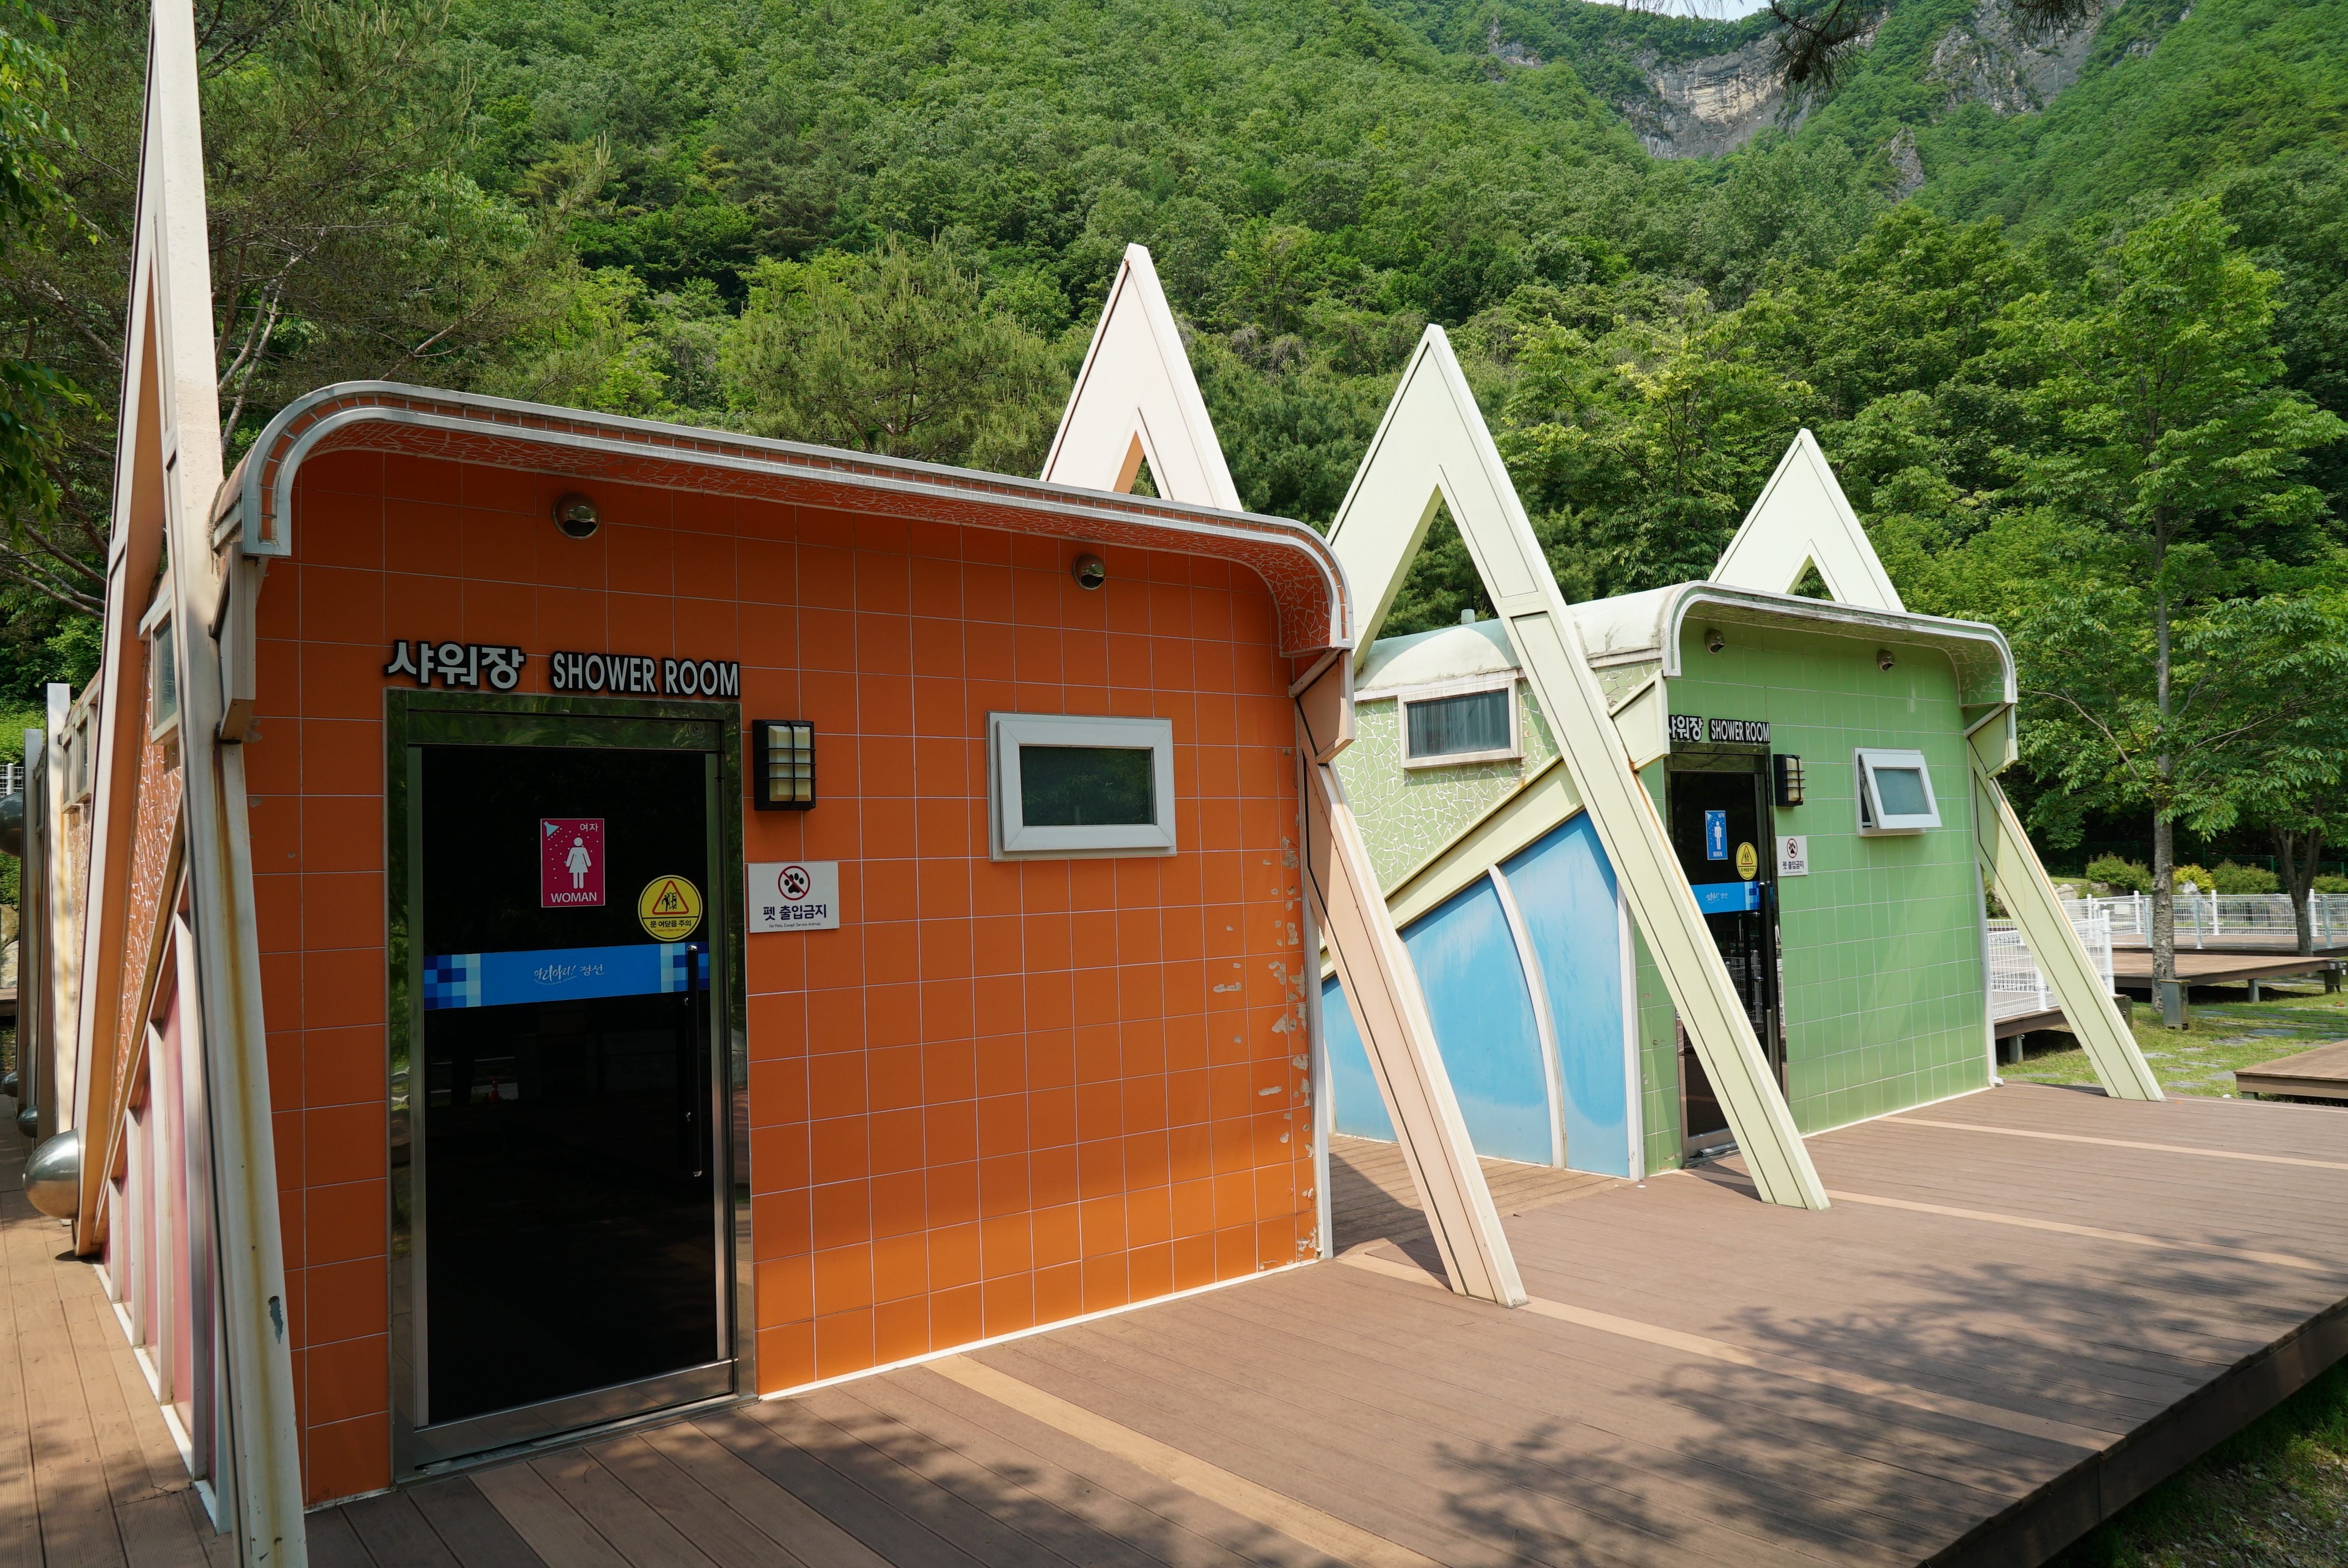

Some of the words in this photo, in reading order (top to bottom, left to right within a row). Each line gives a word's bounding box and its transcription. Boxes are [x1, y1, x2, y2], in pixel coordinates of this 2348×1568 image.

[388, 641, 525, 690] 샤워장
[552, 652, 657, 693] SHOWER
[665, 661, 740, 697] ROOM
[1711, 720, 1744, 741] SHOWER
[1745, 721, 1770, 742] ROOM
[579, 823, 599, 832] 여자
[550, 891, 598, 903] WOMAN
[763, 906, 776, 921] 펫
[779, 904, 827, 921] 출입금지
[579, 963, 605, 976] 정선
